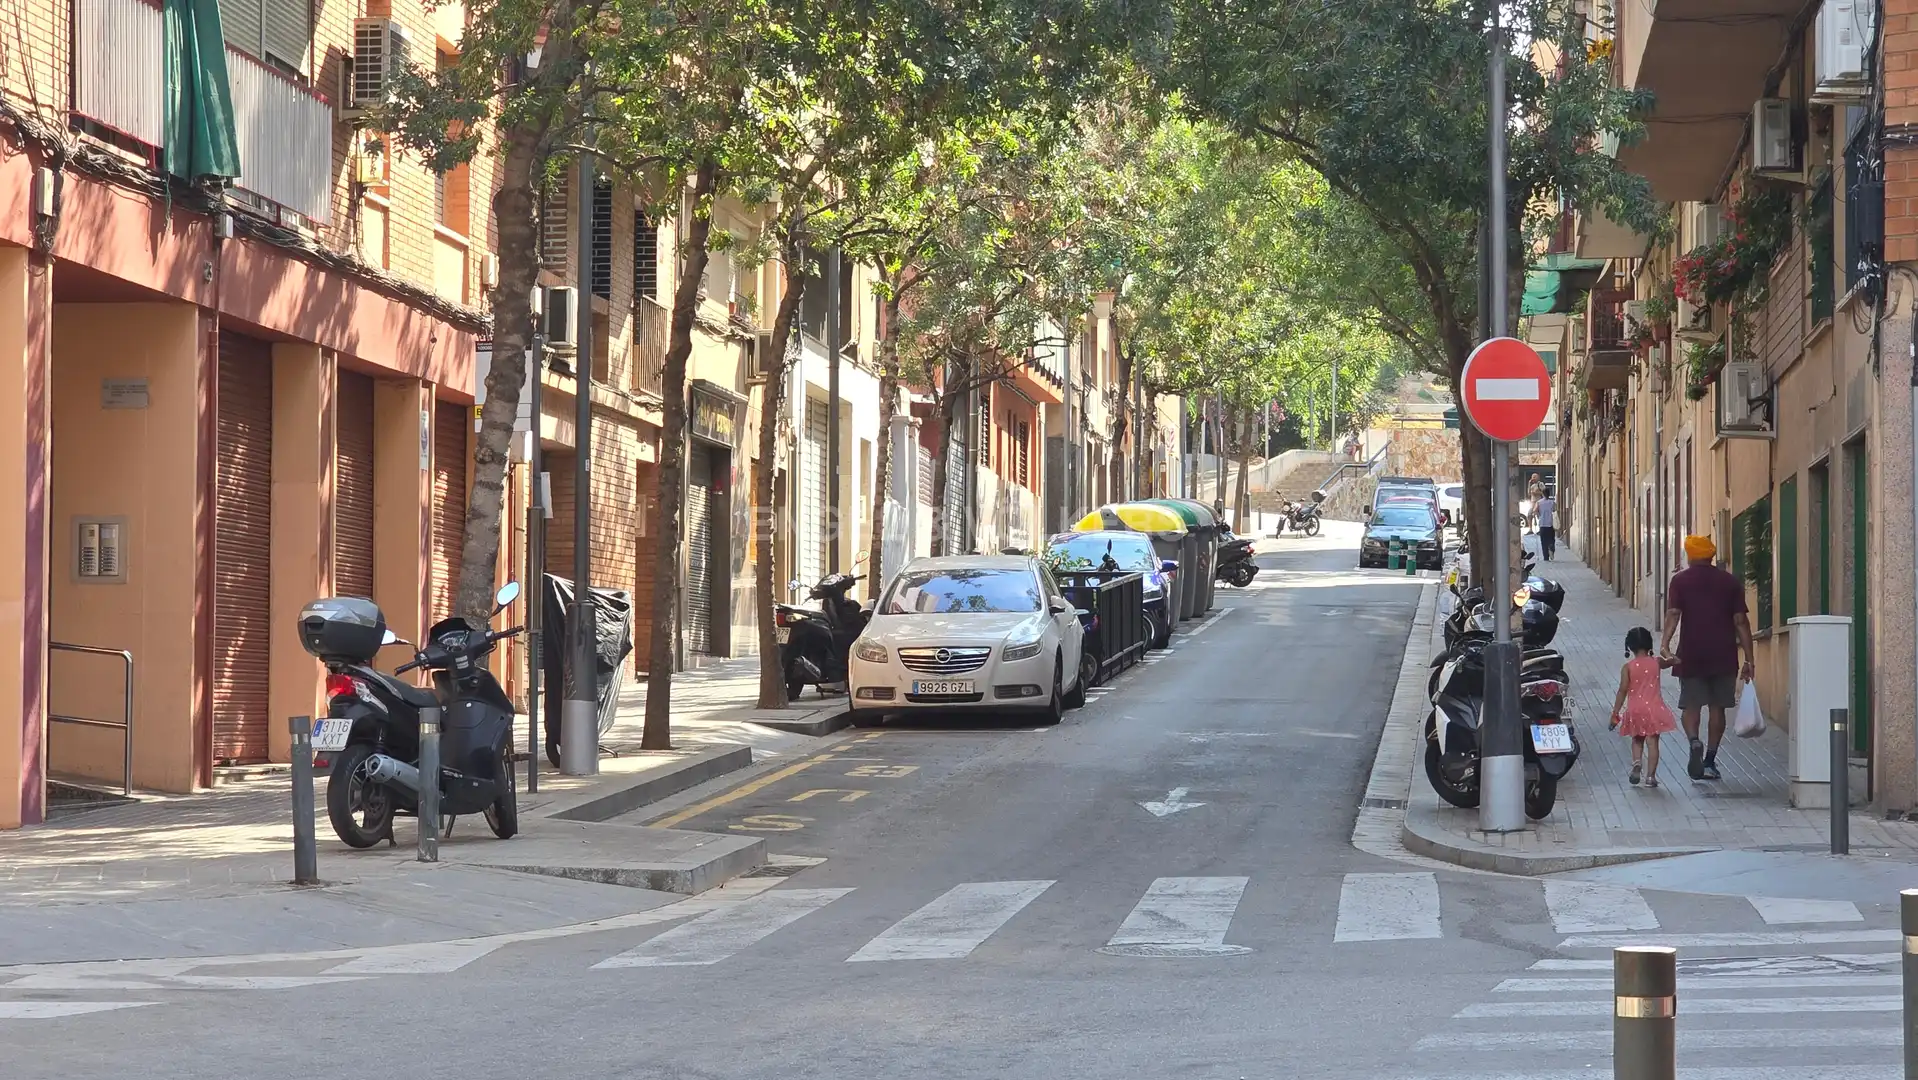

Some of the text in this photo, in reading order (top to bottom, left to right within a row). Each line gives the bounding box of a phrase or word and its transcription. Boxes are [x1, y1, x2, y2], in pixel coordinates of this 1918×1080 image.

[920, 682, 971, 693] 9926 GZL
[321, 720, 350, 733] 3116
[1541, 727, 1566, 737] 4809
[321, 733, 344, 745] KXT
